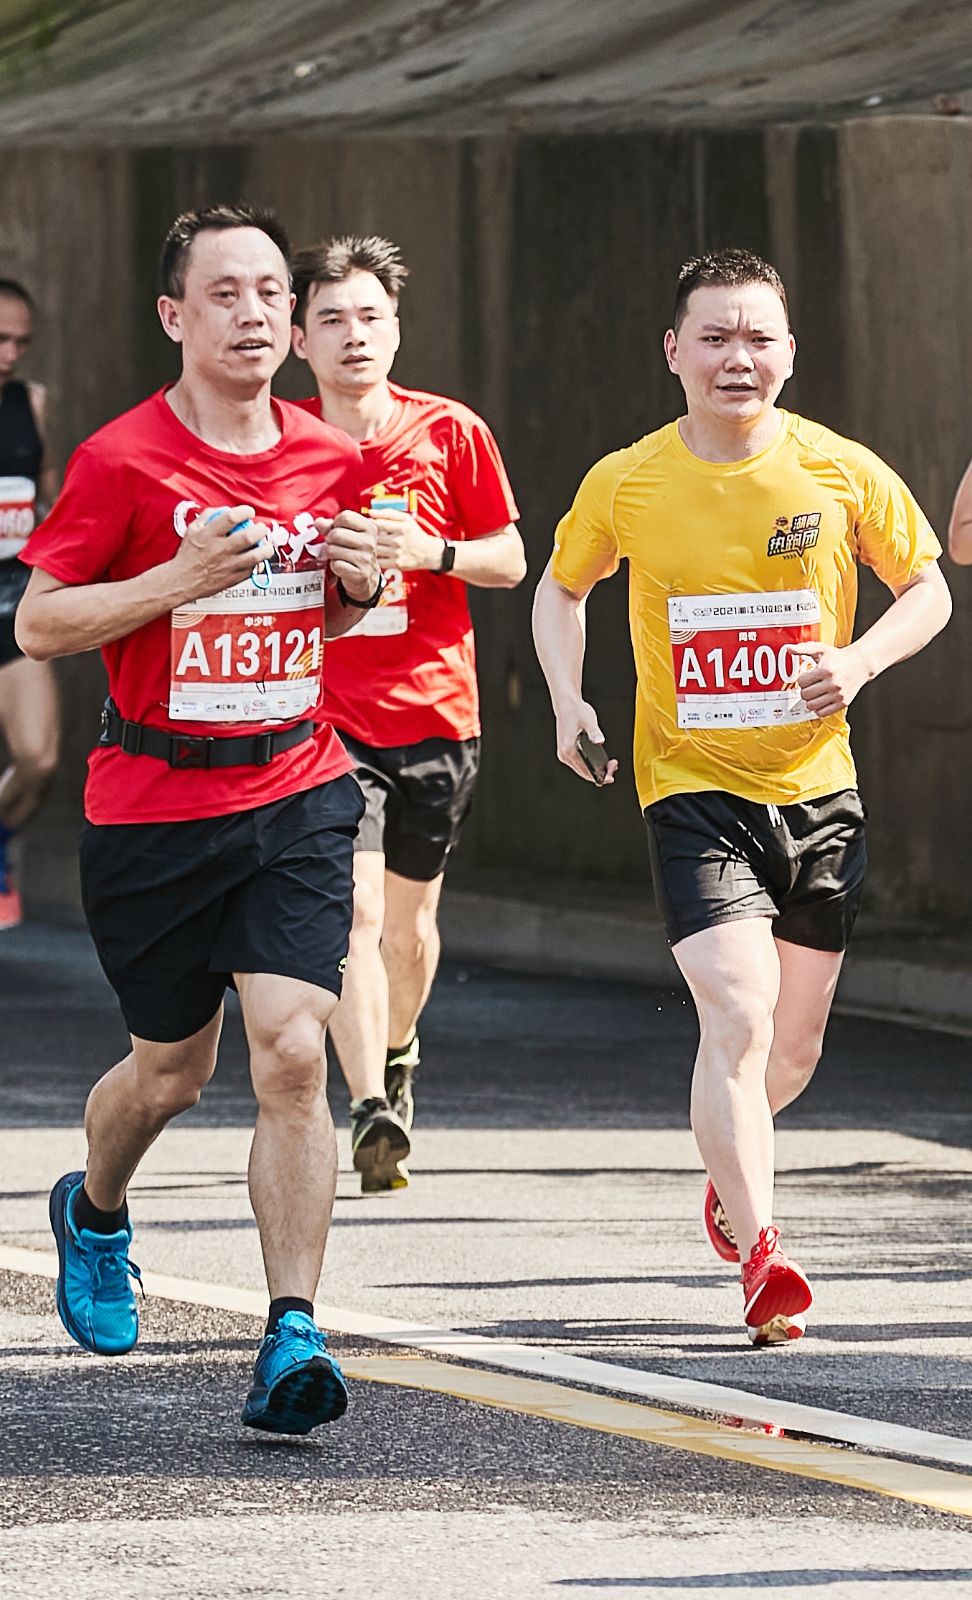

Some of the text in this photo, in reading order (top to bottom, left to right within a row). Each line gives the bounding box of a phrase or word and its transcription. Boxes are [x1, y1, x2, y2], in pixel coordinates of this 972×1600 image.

[768, 528, 819, 556] 热跑团
[175, 627, 320, 676] A13121
